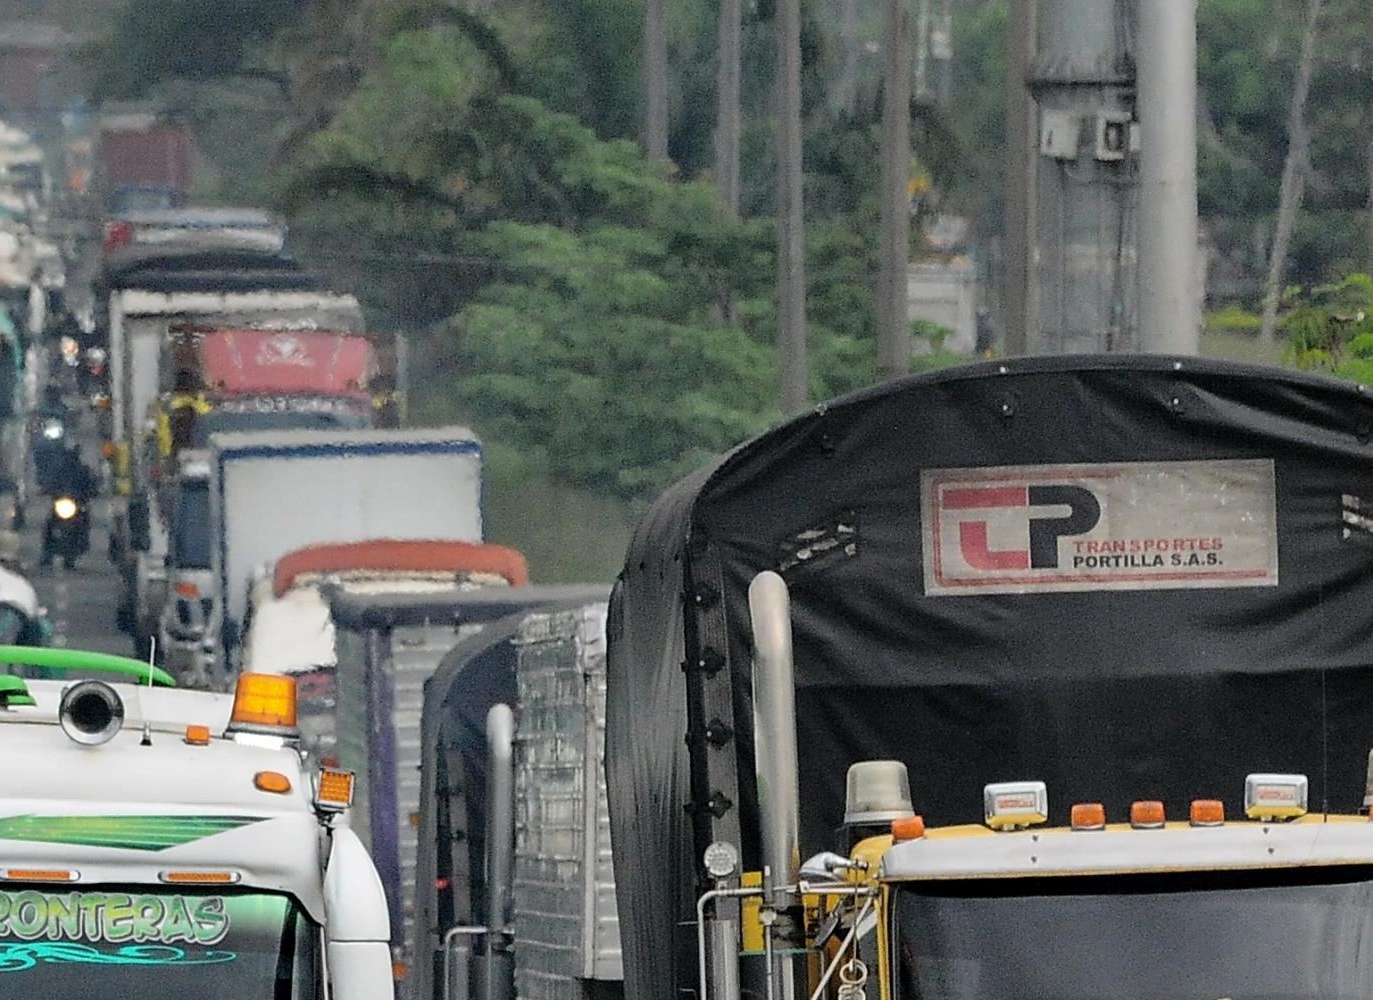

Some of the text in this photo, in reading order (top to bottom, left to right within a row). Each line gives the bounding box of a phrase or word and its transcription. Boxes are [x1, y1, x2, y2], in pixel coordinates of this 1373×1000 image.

[1072, 537, 1224, 554] TRANSPORTES
[1072, 553, 1224, 568] PORTILLA S.A.S.
